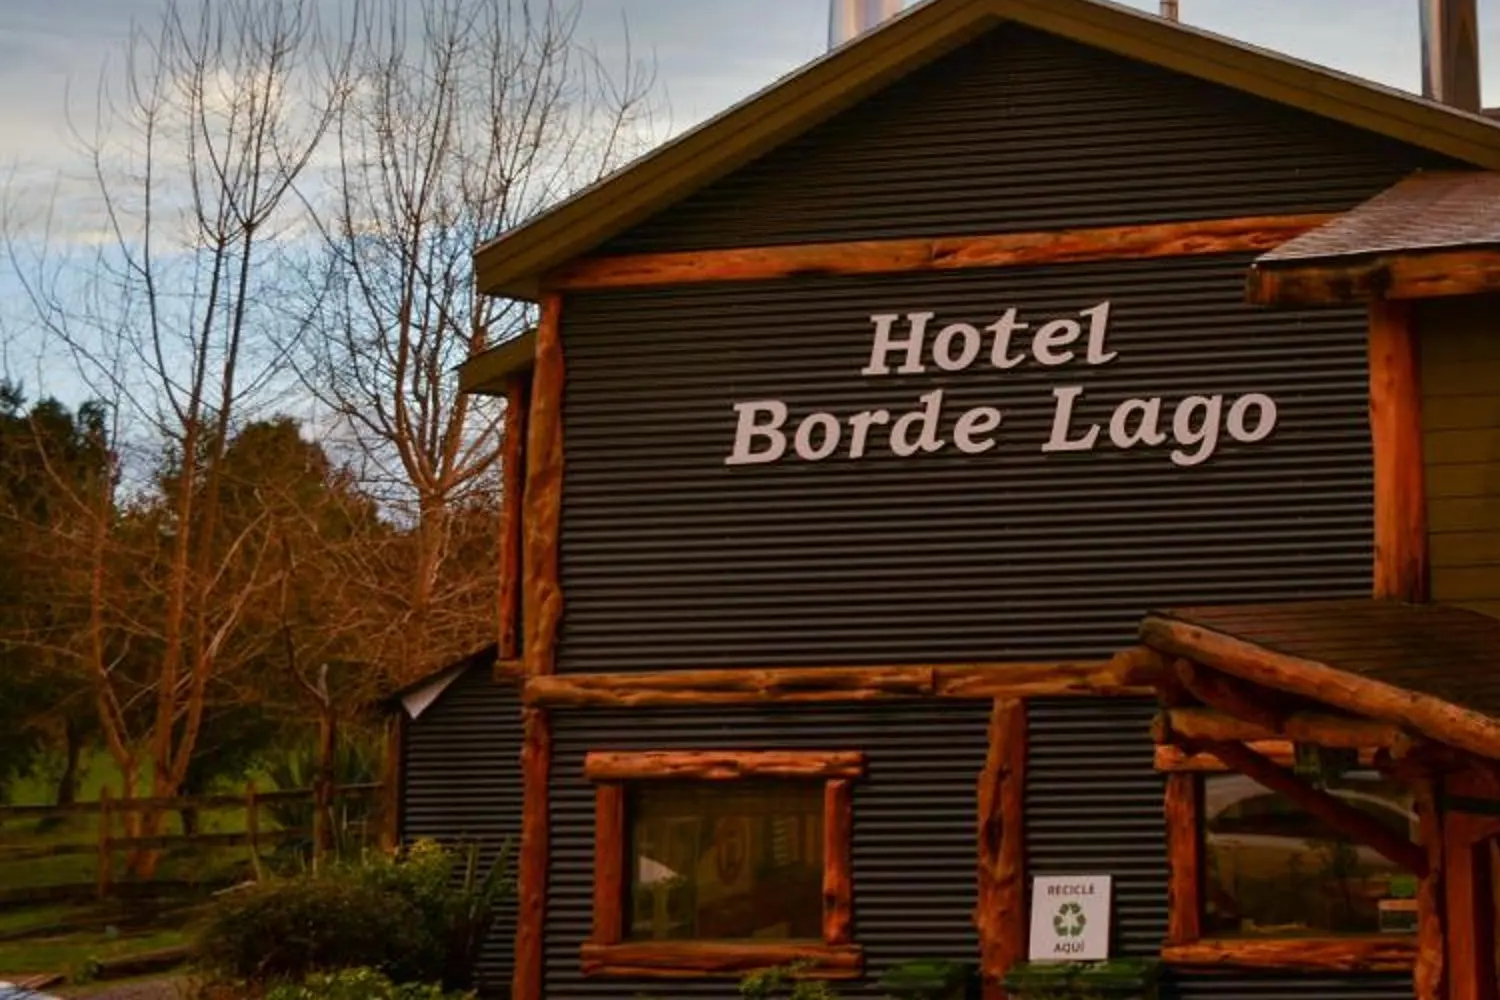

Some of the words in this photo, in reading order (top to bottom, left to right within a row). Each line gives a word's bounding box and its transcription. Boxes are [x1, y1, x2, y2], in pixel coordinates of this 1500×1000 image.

[862, 301, 1118, 375] Hotel
[725, 390, 1000, 465] Borde
[1042, 386, 1277, 466] Lago
[1047, 884, 1095, 896] RECICLE
